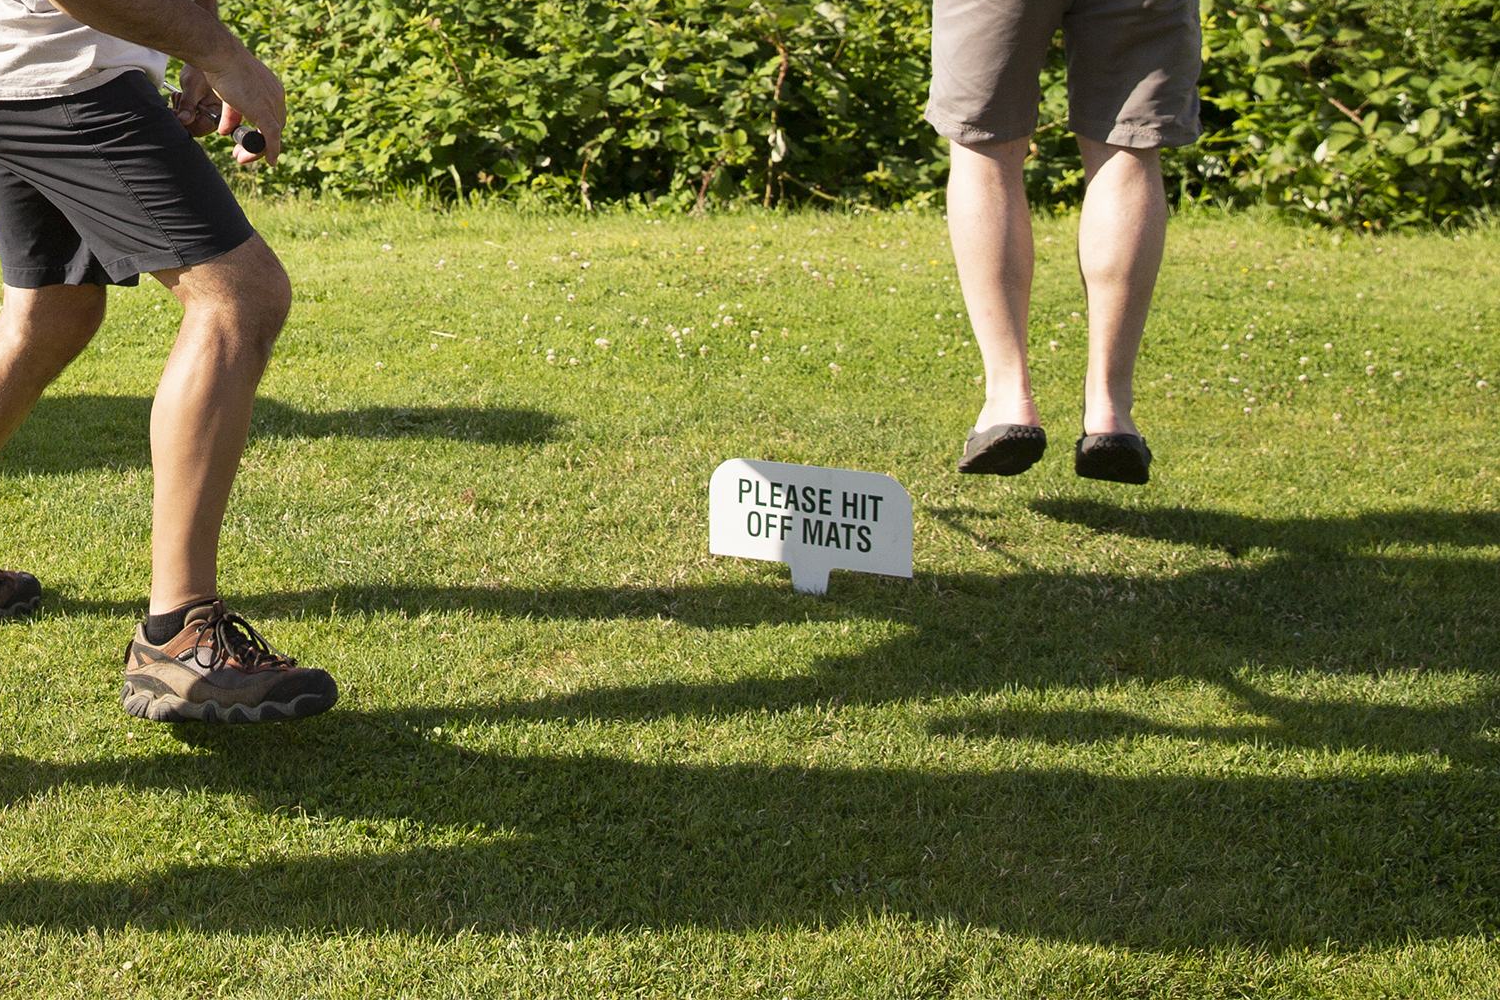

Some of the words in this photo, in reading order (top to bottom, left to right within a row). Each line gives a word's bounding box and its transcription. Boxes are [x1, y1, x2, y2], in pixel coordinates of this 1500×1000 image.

[738, 478, 832, 516] PLEASE
[842, 491, 883, 522] HIT
[747, 511, 793, 541] OFF
[802, 518, 872, 553] MATS
